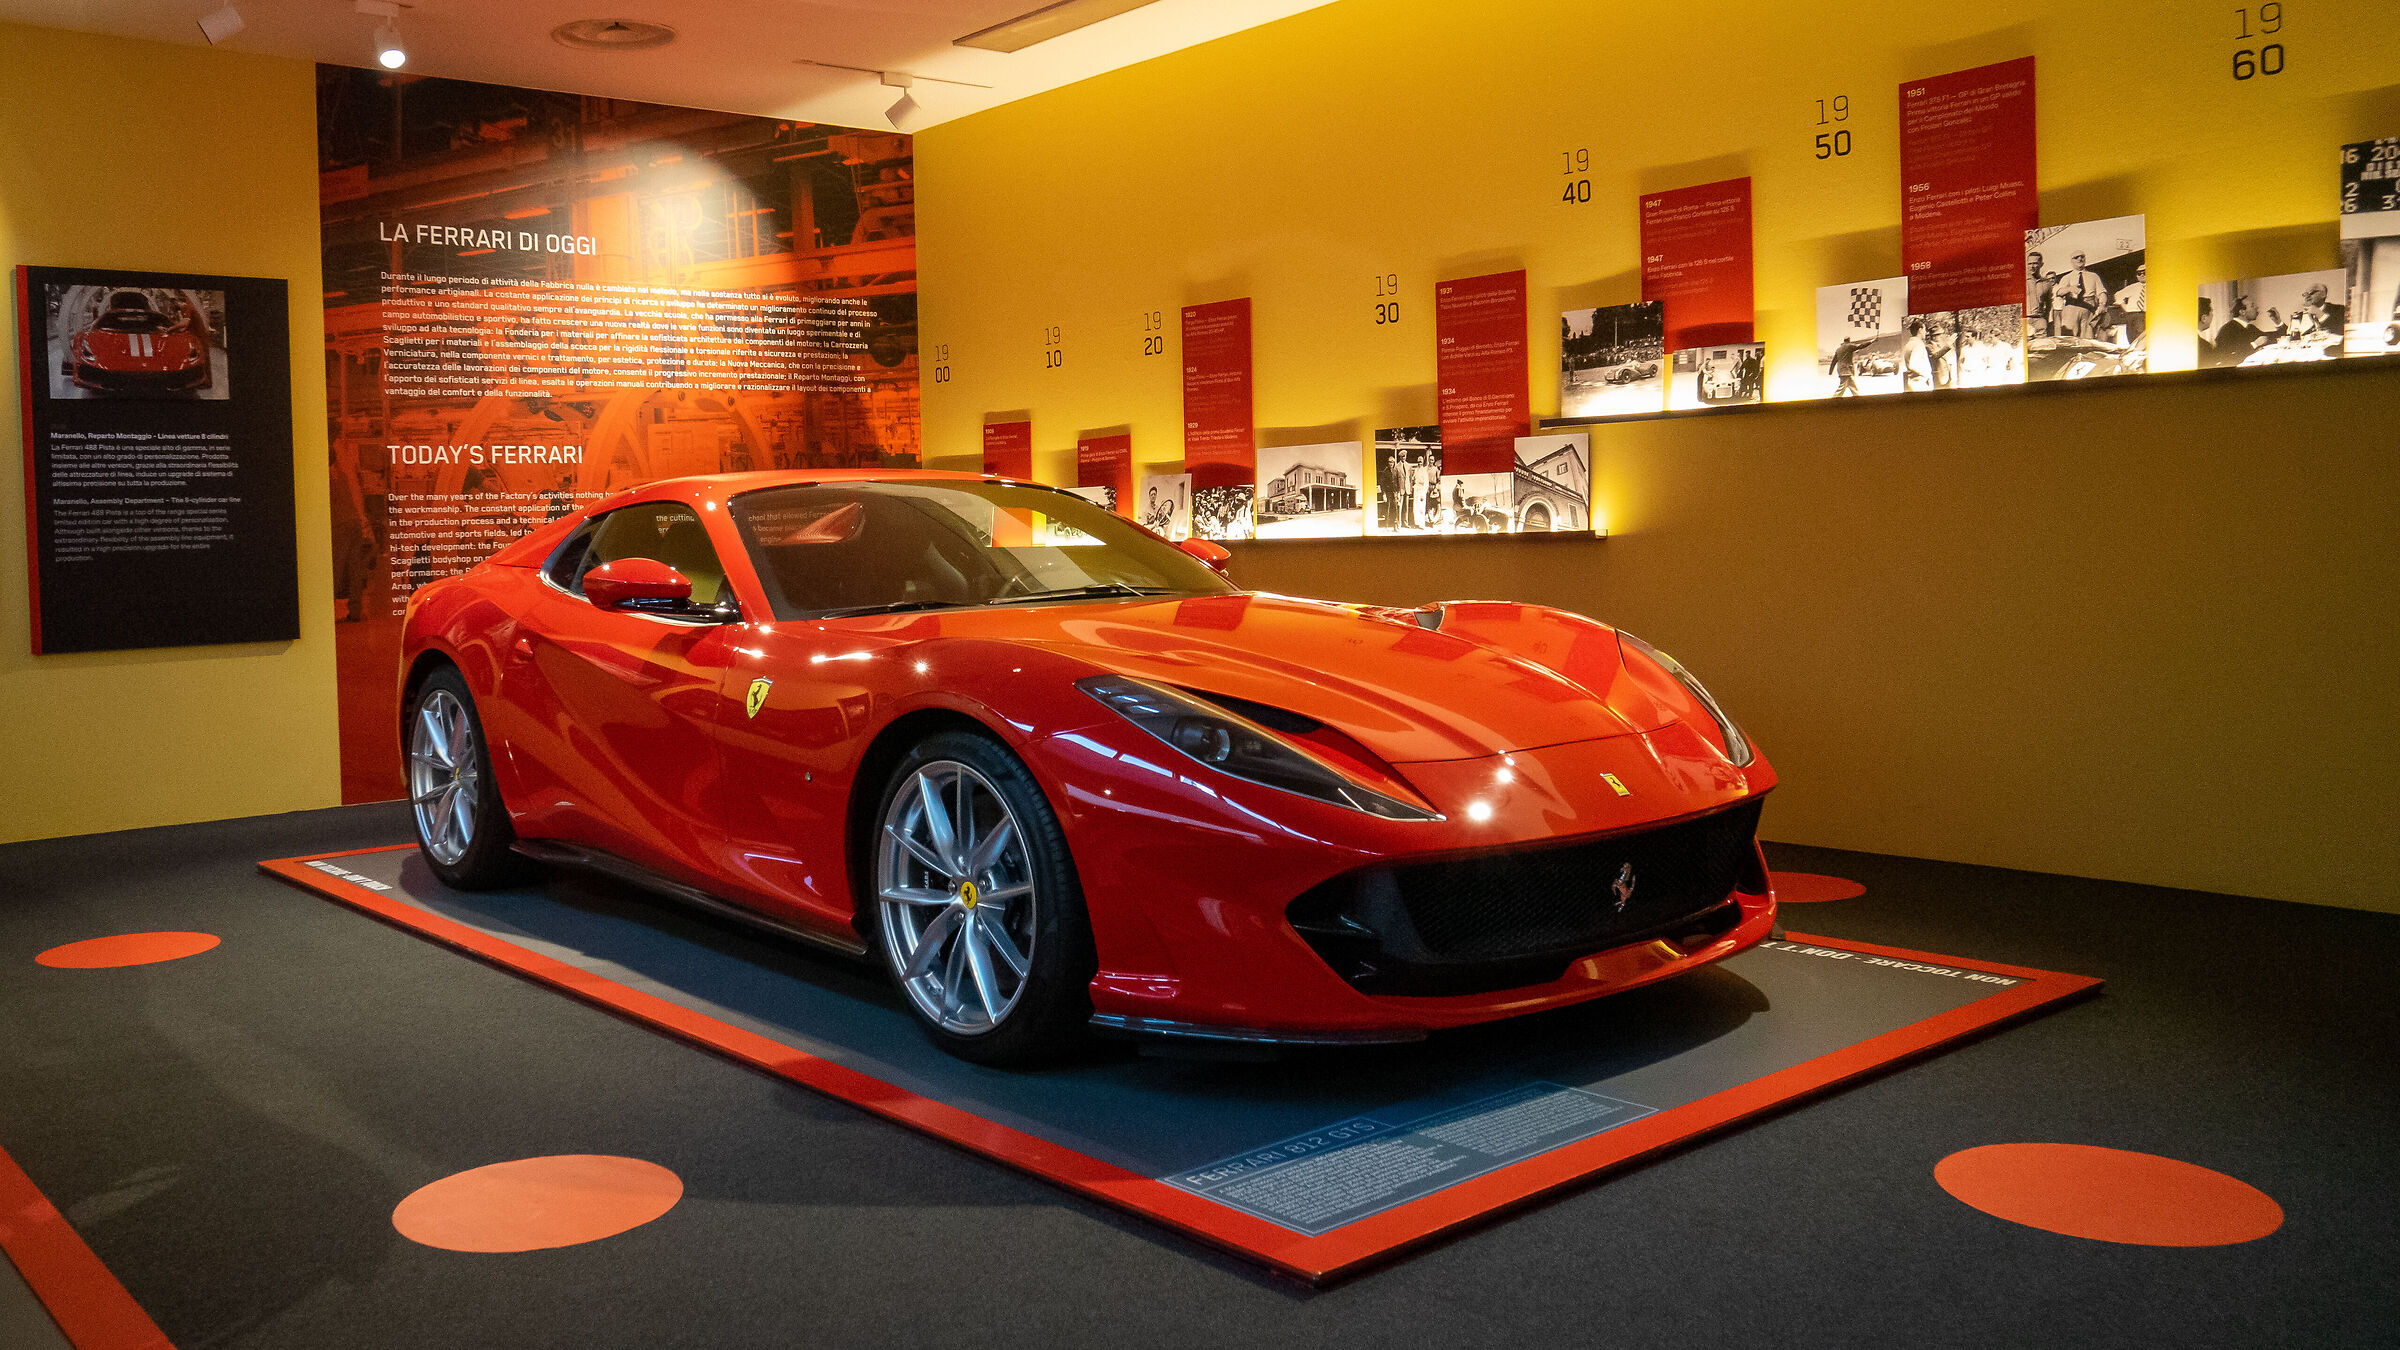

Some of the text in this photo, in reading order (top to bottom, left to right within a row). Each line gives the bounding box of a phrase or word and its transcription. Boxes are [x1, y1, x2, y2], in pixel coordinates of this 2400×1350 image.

[2234, 2, 2283, 40] 19
[2232, 43, 2285, 81] 60
[1906, 87, 1926, 98] 1951
[1815, 95, 1849, 126] 19
[1815, 130, 1852, 160] 50
[1562, 148, 1590, 175] 19
[1562, 179, 1591, 205] 40
[1908, 183, 1930, 193] 1956
[1645, 199, 1662, 209] 1947
[379, 221, 597, 256] LA FERRARI DI OGGI
[1647, 254, 1664, 264] 1947
[380, 271, 594, 290] Durante il lungo periodo di attività della Fabbrica nulla
[1375, 273, 1398, 298] 19
[380, 284, 530, 299] performance artigianali. La costante
[381, 297, 426, 309] produttivo
[451, 300, 489, 309] standard
[489, 302, 531, 313] qualitativo
[1375, 302, 1400, 325] 30
[1143, 311, 1162, 332] 19
[382, 335, 424, 346] Scaglietti
[1045, 326, 1062, 346] 19
[1441, 337, 1455, 345] 1934
[1143, 335, 1164, 357] 20
[383, 347, 539, 361] Verniciatura, nella componente vernici
[934, 344, 950, 362] 19
[1046, 349, 1063, 369] 10
[383, 360, 507, 371] l'accuratezza delle lavorazioni
[727, 359, 786, 369] Nuova Meccanica,
[383, 373, 479, 384] l'apporto dei sofisticati
[935, 366, 951, 384] 00
[384, 385, 426, 396] vantaggio
[427, 386, 440, 394] del
[441, 387, 475, 395] comfort
[483, 388, 503, 396] della
[504, 388, 552, 397] funzionalità.
[1442, 388, 1456, 396] 1934
[51, 432, 87, 440] Maranello,
[88, 432, 115, 440] Reparto
[116, 433, 152, 441] Montaggio
[387, 443, 583, 465] TODAY'S FERRARI
[388, 491, 603, 502] Over the many years of the Factory's activities nothing
[388, 503, 584, 515] the workmanship. The constant application of the
[389, 518, 397, 526] in
[398, 518, 413, 526] the
[414, 517, 459, 528] production
[461, 519, 494, 527] process
[496, 516, 510, 524] and
[519, 516, 554, 524] technical
[656, 514, 668, 522] the
[389, 530, 436, 539] automotive
[437, 530, 453, 538] and
[454, 529, 482, 539] sports
[483, 529, 508, 538] fields,
[523, 528, 531, 536] to
[389, 541, 491, 552] hi-tech development: the
[390, 555, 430, 566] Scaglietti
[432, 555, 471, 565] bodyshop
[390, 568, 448, 579] performance;
[390, 581, 414, 590] Area,
[1862, 957, 1963, 978] TOCCARE
[1963, 973, 2018, 986] NON
[1186, 1150, 1288, 1186] FERRARI
[1328, 1120, 1376, 1142] GTS
